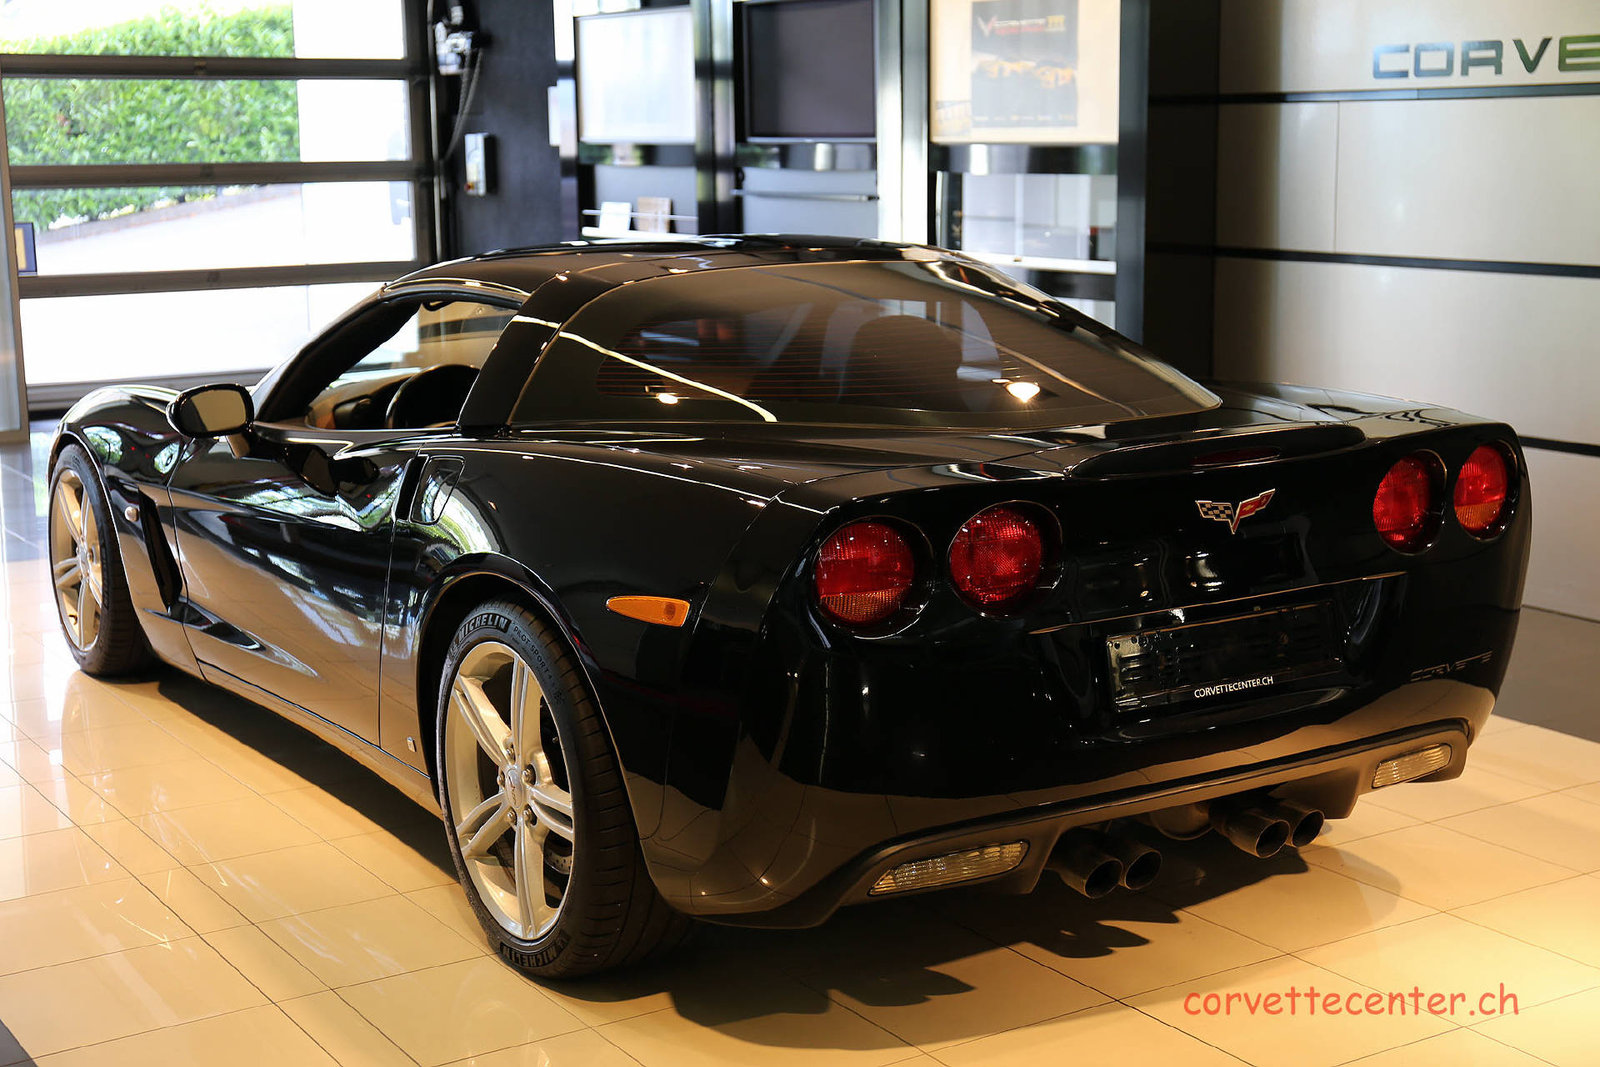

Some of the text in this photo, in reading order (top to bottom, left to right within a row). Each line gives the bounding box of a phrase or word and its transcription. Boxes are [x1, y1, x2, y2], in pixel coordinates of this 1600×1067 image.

[1373, 34, 1600, 79] CORVE
[458, 614, 508, 641] MICHELIN
[513, 626, 531, 645] PILOT
[530, 645, 550, 673] SPORT
[1194, 676, 1274, 698] CORVETTECENTER.CH
[503, 945, 557, 967] MICHELIN
